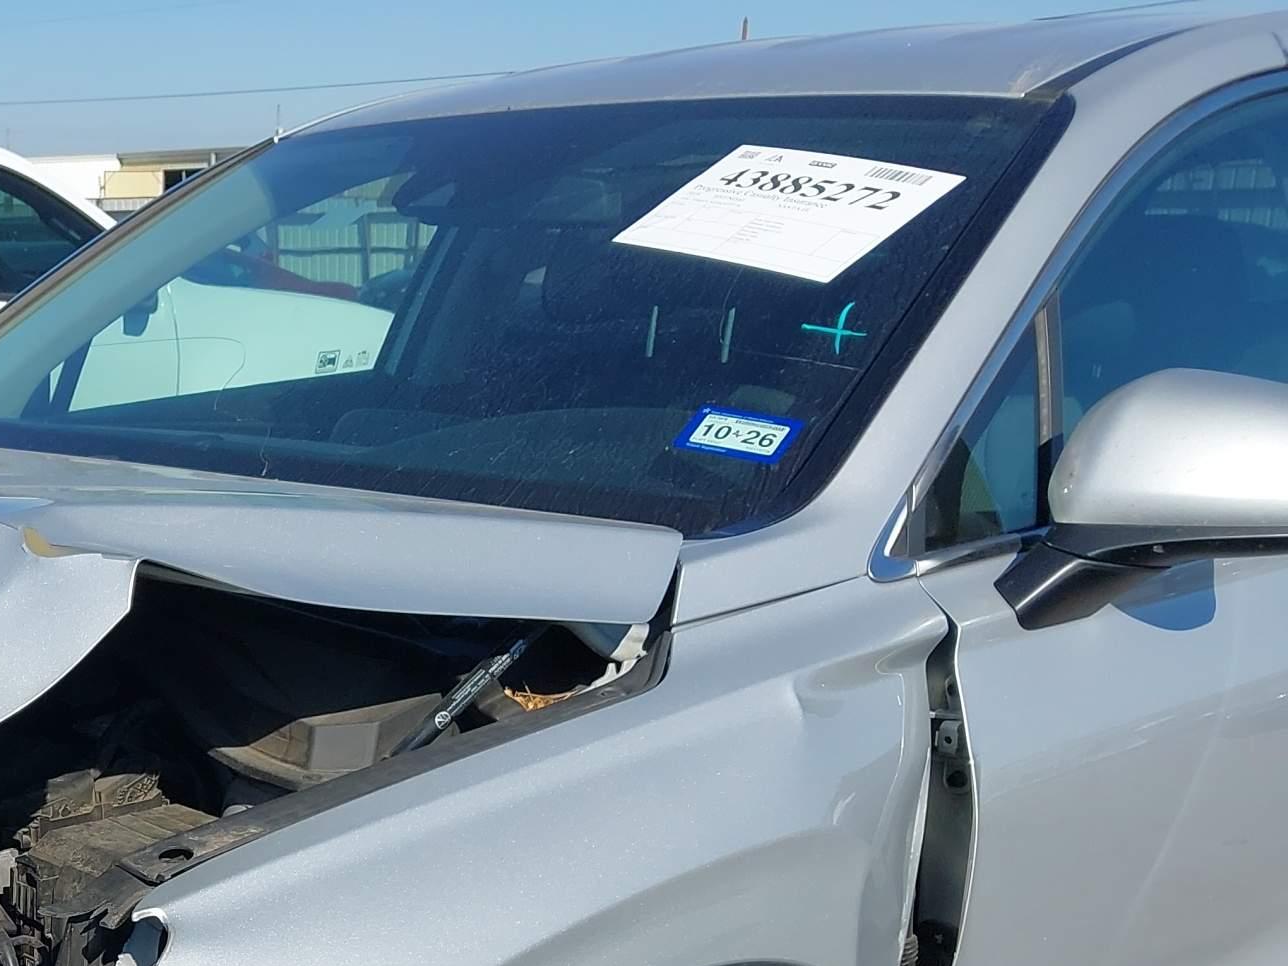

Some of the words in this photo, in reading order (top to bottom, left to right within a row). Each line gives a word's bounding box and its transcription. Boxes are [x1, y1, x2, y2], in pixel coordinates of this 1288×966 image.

[719, 168, 901, 210] 43885272
[702, 423, 732, 440] 10
[740, 430, 777, 447] 26
